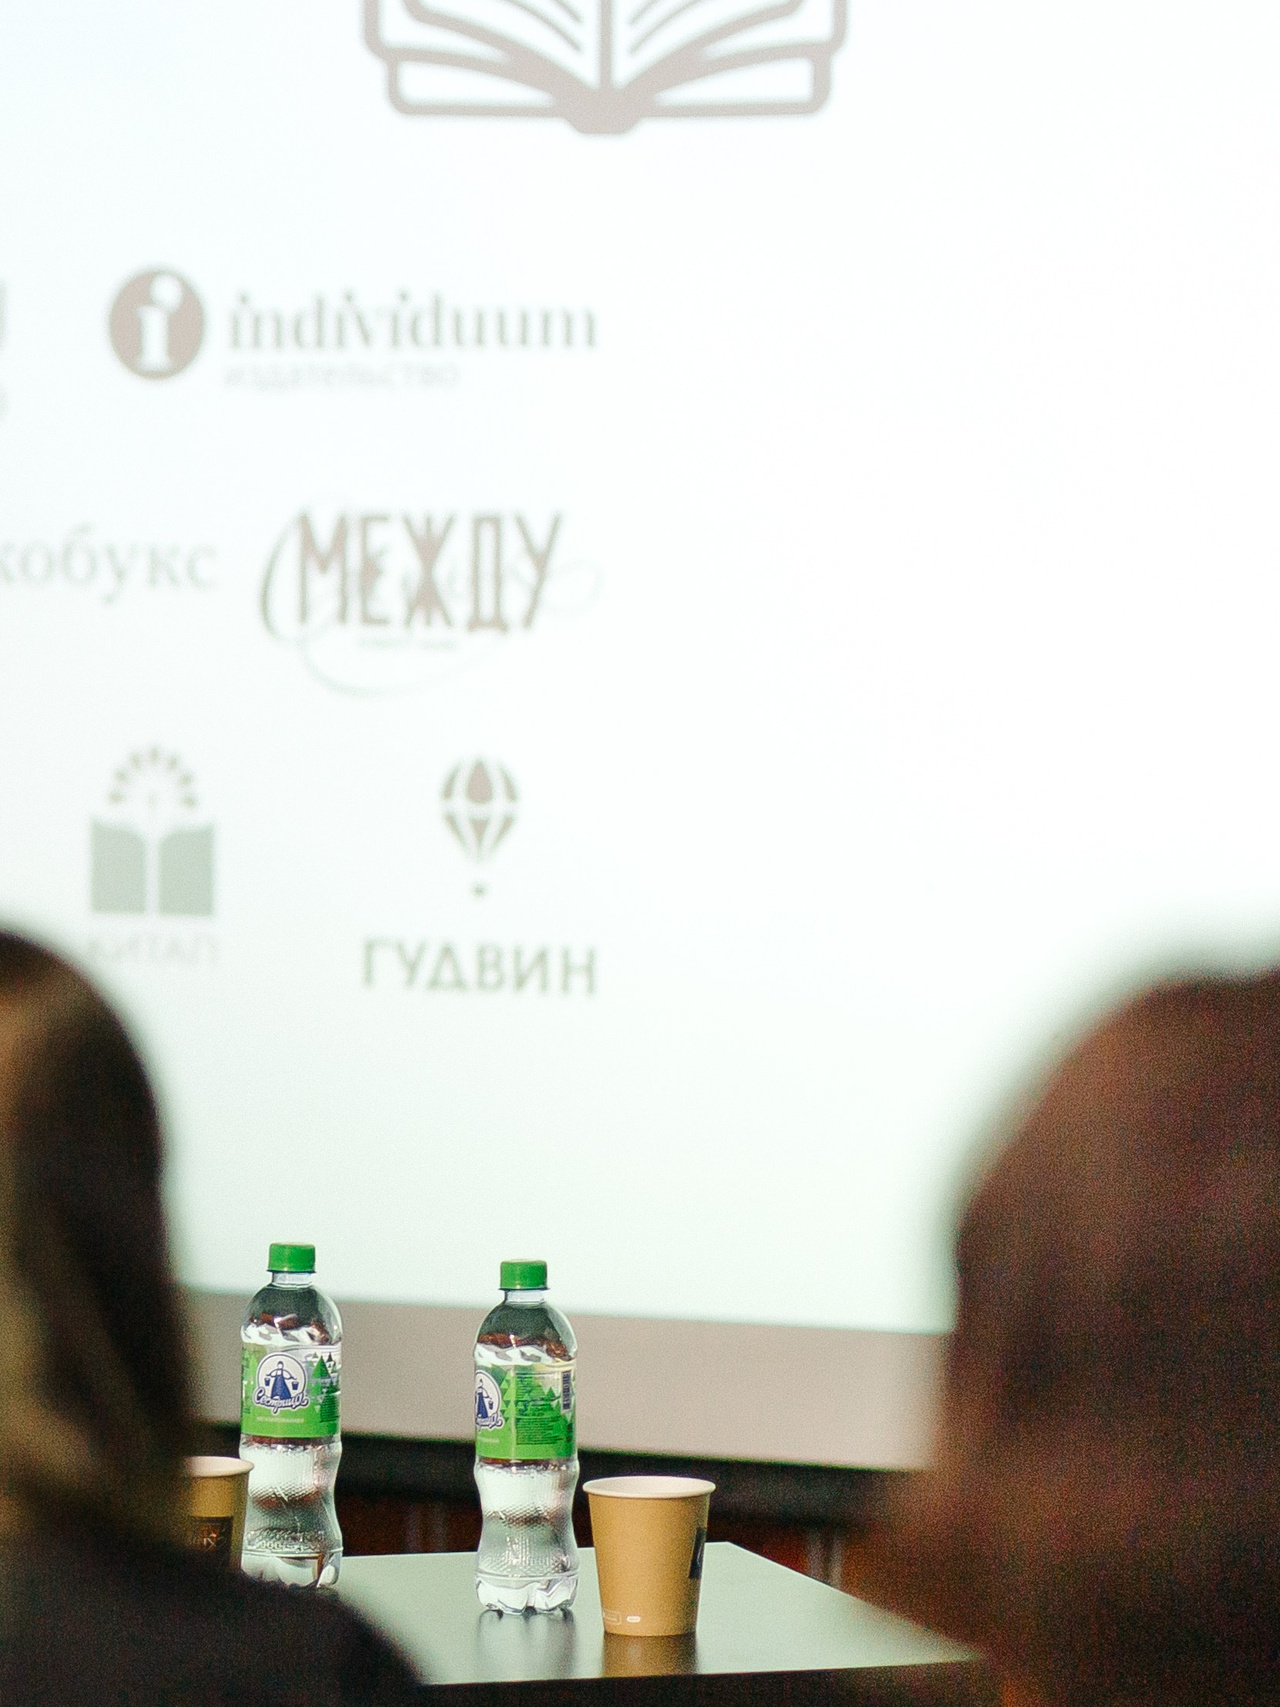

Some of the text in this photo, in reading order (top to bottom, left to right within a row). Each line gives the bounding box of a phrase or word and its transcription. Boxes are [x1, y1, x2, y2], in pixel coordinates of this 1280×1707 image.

[228, 287, 598, 350] individuum
[298, 511, 563, 634] МЕЖДУ
[363, 938, 598, 996] ГУДВИН
